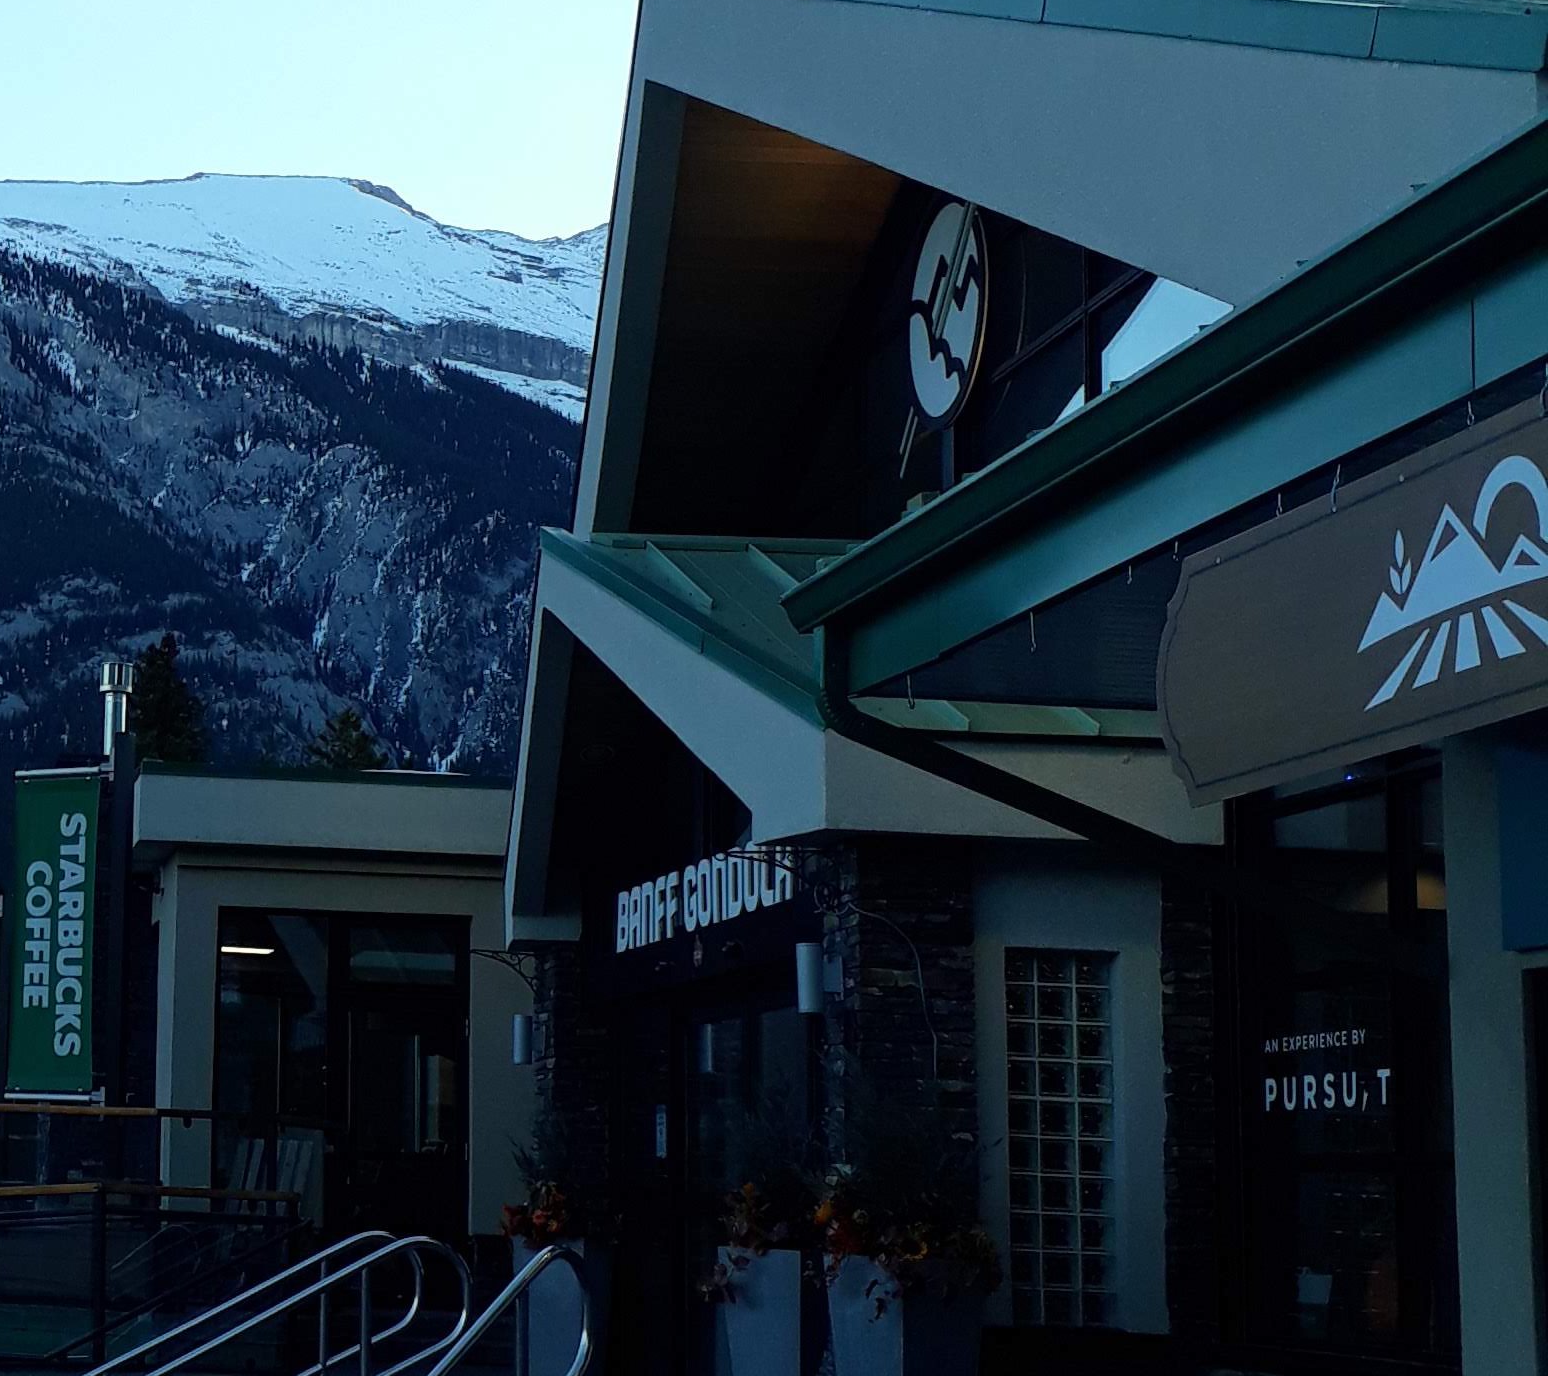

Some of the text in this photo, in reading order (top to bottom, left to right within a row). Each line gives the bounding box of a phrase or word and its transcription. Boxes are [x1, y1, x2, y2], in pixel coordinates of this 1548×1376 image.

[22, 860, 53, 1008] COFFEE
[53, 812, 87, 1056] STARBUCKS
[616, 840, 794, 954] BANFF GONDOLA
[1264, 1028, 1366, 1054] AN EXPERIENCE BY
